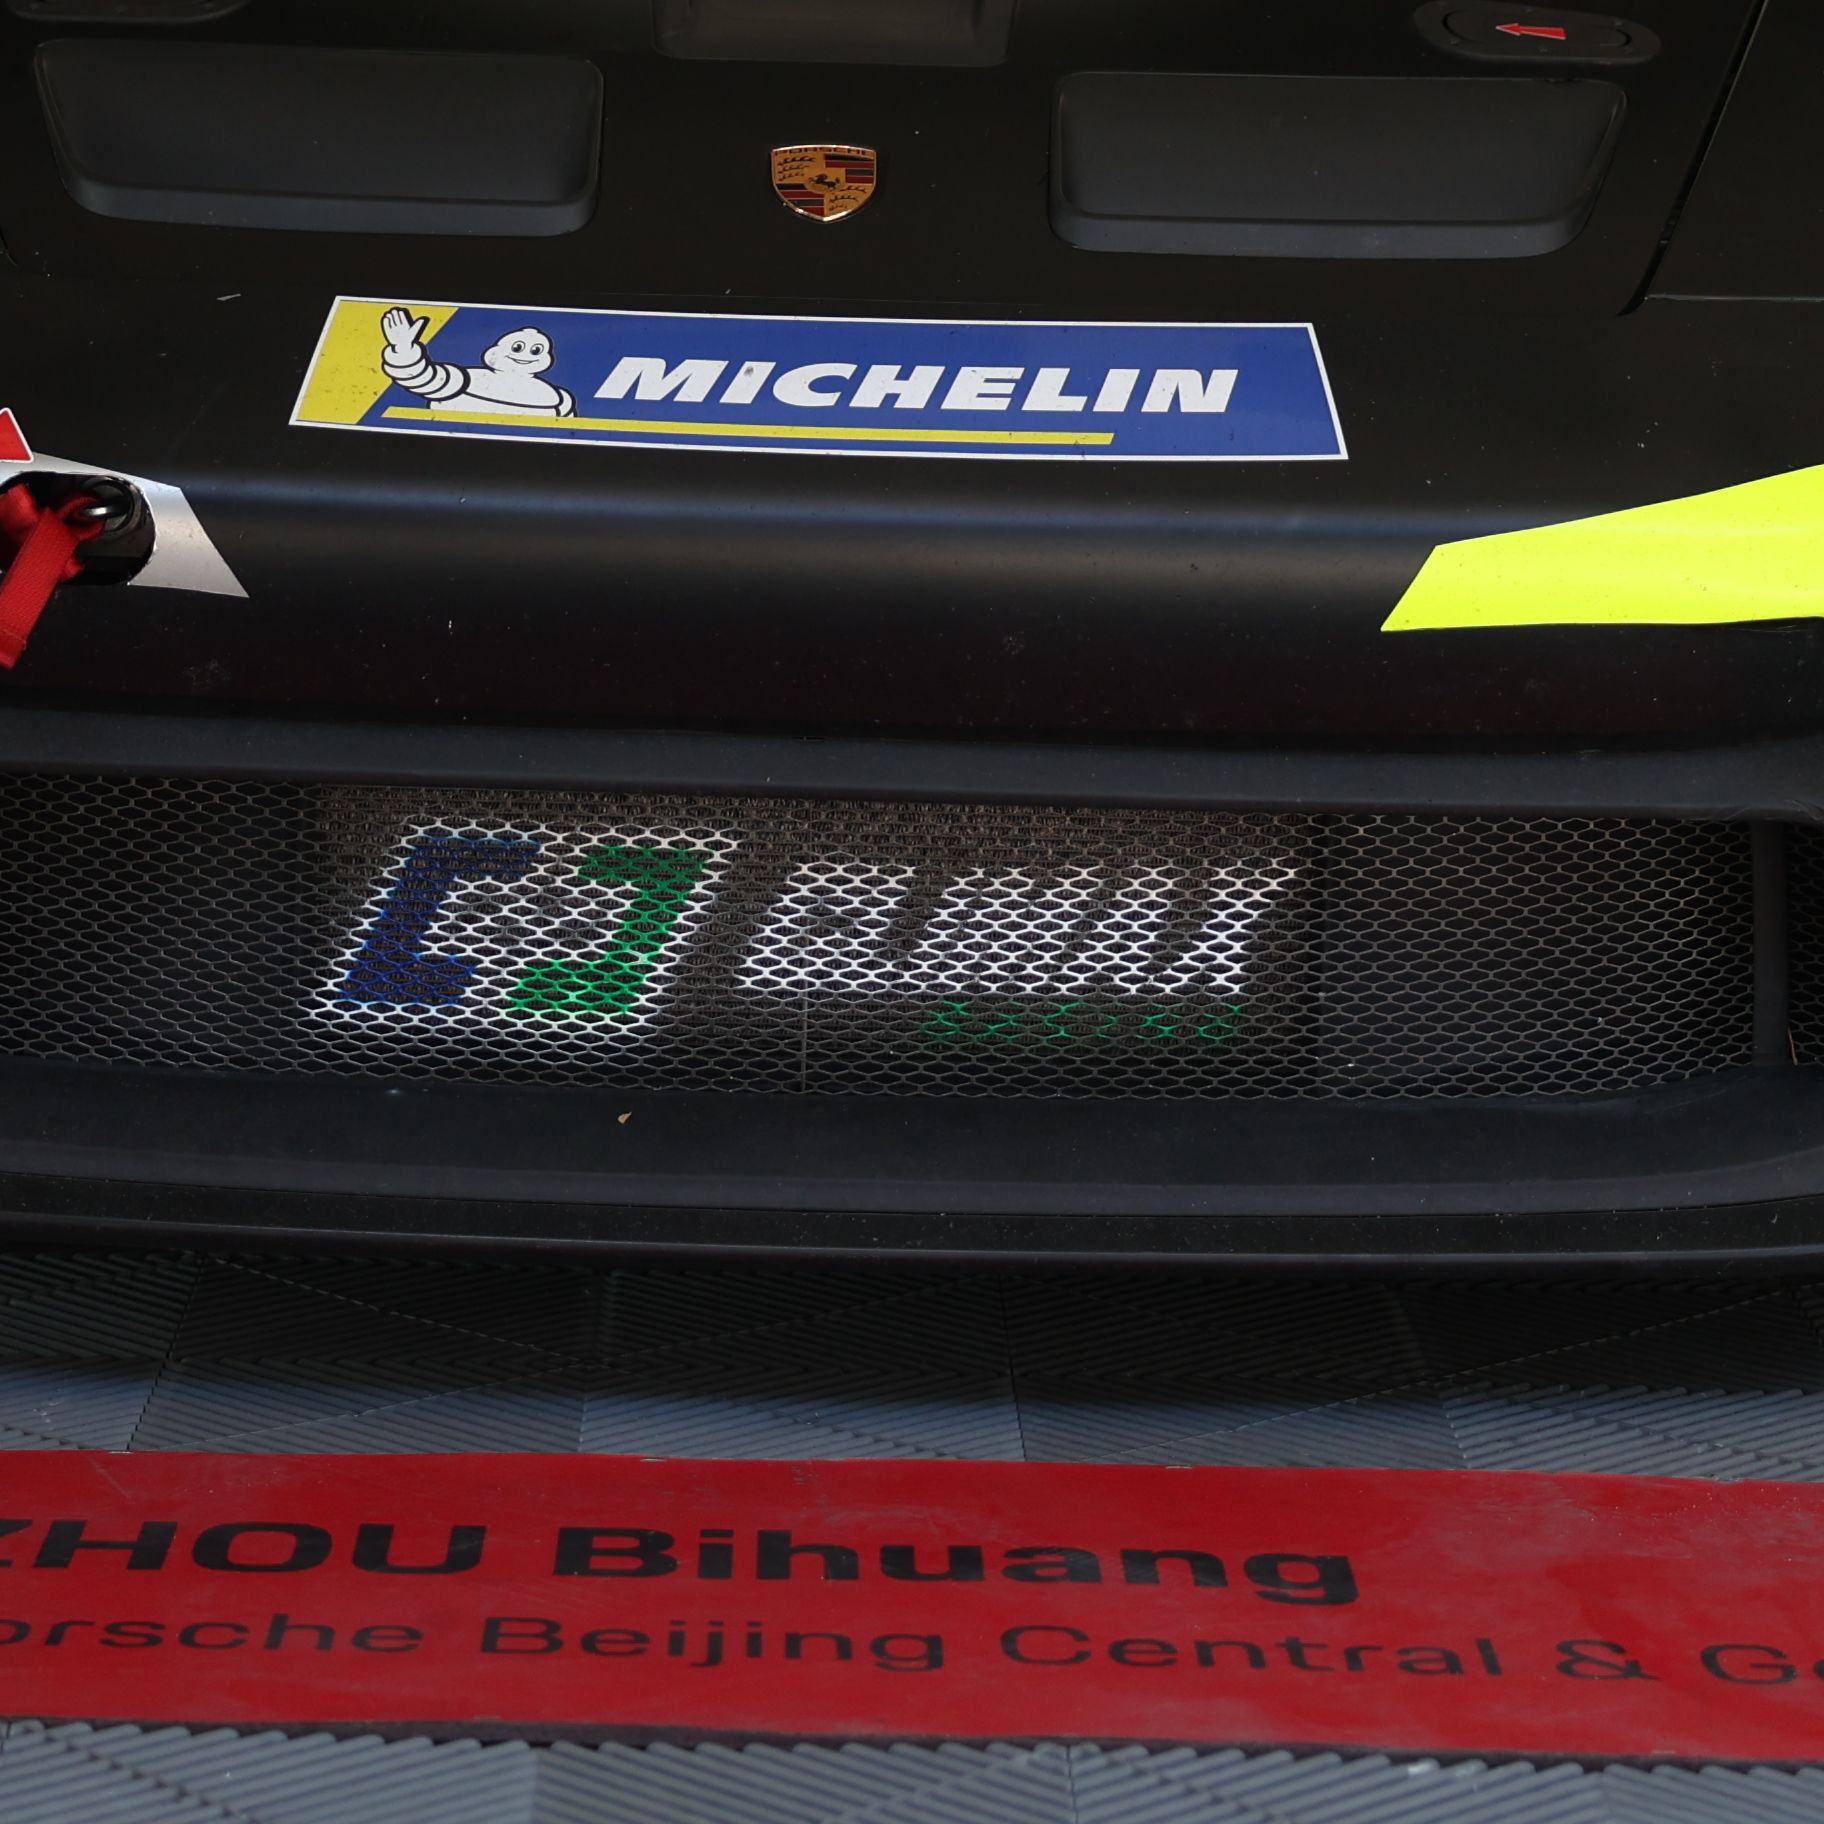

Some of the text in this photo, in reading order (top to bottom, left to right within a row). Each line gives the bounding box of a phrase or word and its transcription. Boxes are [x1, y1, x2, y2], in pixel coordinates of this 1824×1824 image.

[593, 355, 1239, 414] MICHELIN
[551, 1525, 1359, 1606] Bihuang
[478, 1615, 946, 1673] Beijing
[998, 1622, 1501, 1678] Central
[1555, 1637, 1659, 1683] &
